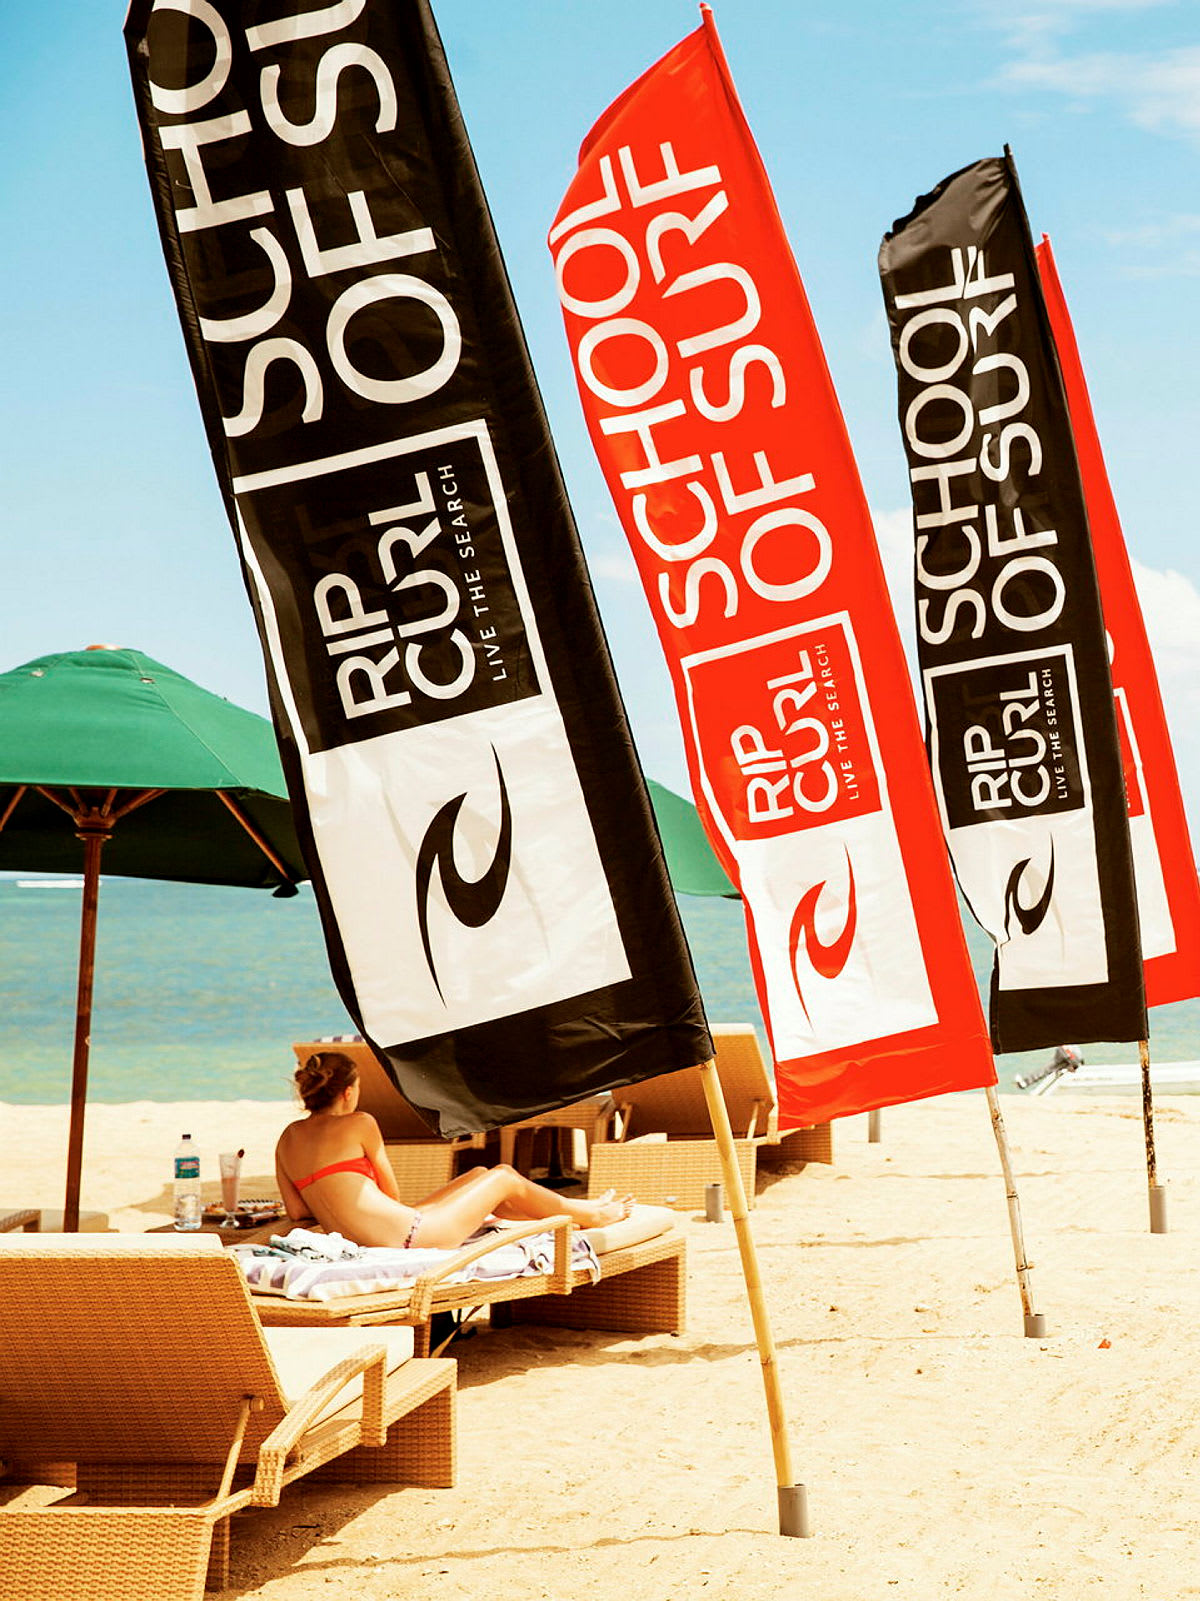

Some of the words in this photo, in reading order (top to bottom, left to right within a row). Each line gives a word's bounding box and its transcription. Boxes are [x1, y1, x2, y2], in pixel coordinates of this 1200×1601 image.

[285, 186, 462, 404] OF
[618, 141, 786, 422] SURF
[549, 154, 739, 629] SCHOOL
[963, 245, 1042, 482] SURF
[894, 247, 986, 645] SCHOOL
[437, 464, 475, 558] SEARCH
[711, 450, 833, 602] OF
[367, 471, 476, 700] CURL
[464, 570, 489, 618] THE
[985, 505, 1066, 632] OF
[313, 572, 412, 720] RIP
[481, 627, 507, 682] LIVE
[814, 643, 840, 711] SEARCH
[1041, 668, 1058, 726] SEARCH
[730, 724, 794, 823] RIP
[766, 650, 838, 812] CURL
[831, 718, 847, 753] THE
[840, 760, 859, 800] LIVE
[963, 724, 1012, 811] RIP
[1000, 671, 1050, 807] CURL
[1048, 731, 1063, 761] THE
[1055, 766, 1068, 799] LIVE
